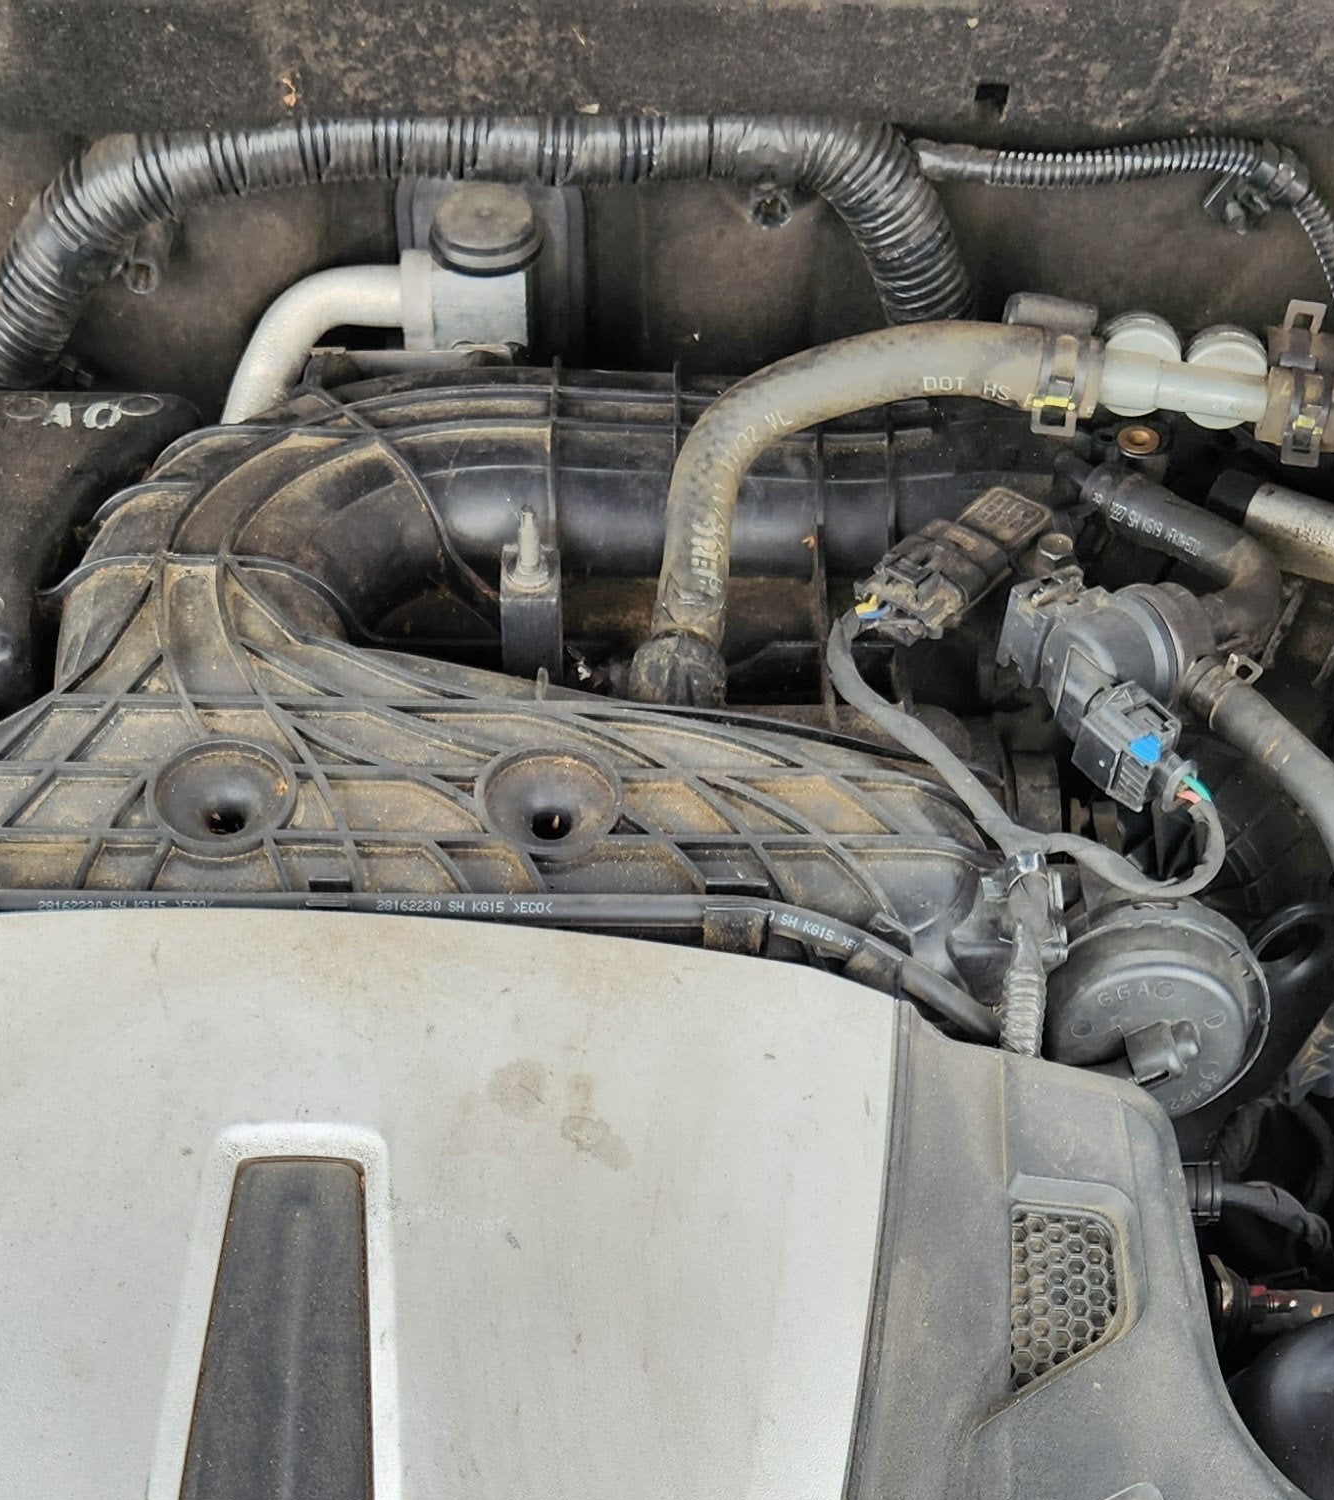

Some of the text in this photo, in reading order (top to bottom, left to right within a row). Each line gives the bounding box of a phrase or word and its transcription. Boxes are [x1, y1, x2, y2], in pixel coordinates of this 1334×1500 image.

[921, 375, 966, 392] DOT
[982, 380, 1011, 402] HS
[376, 898, 442, 914] 28162230
[447, 899, 466, 914] SH
[780, 913, 799, 931] SH
